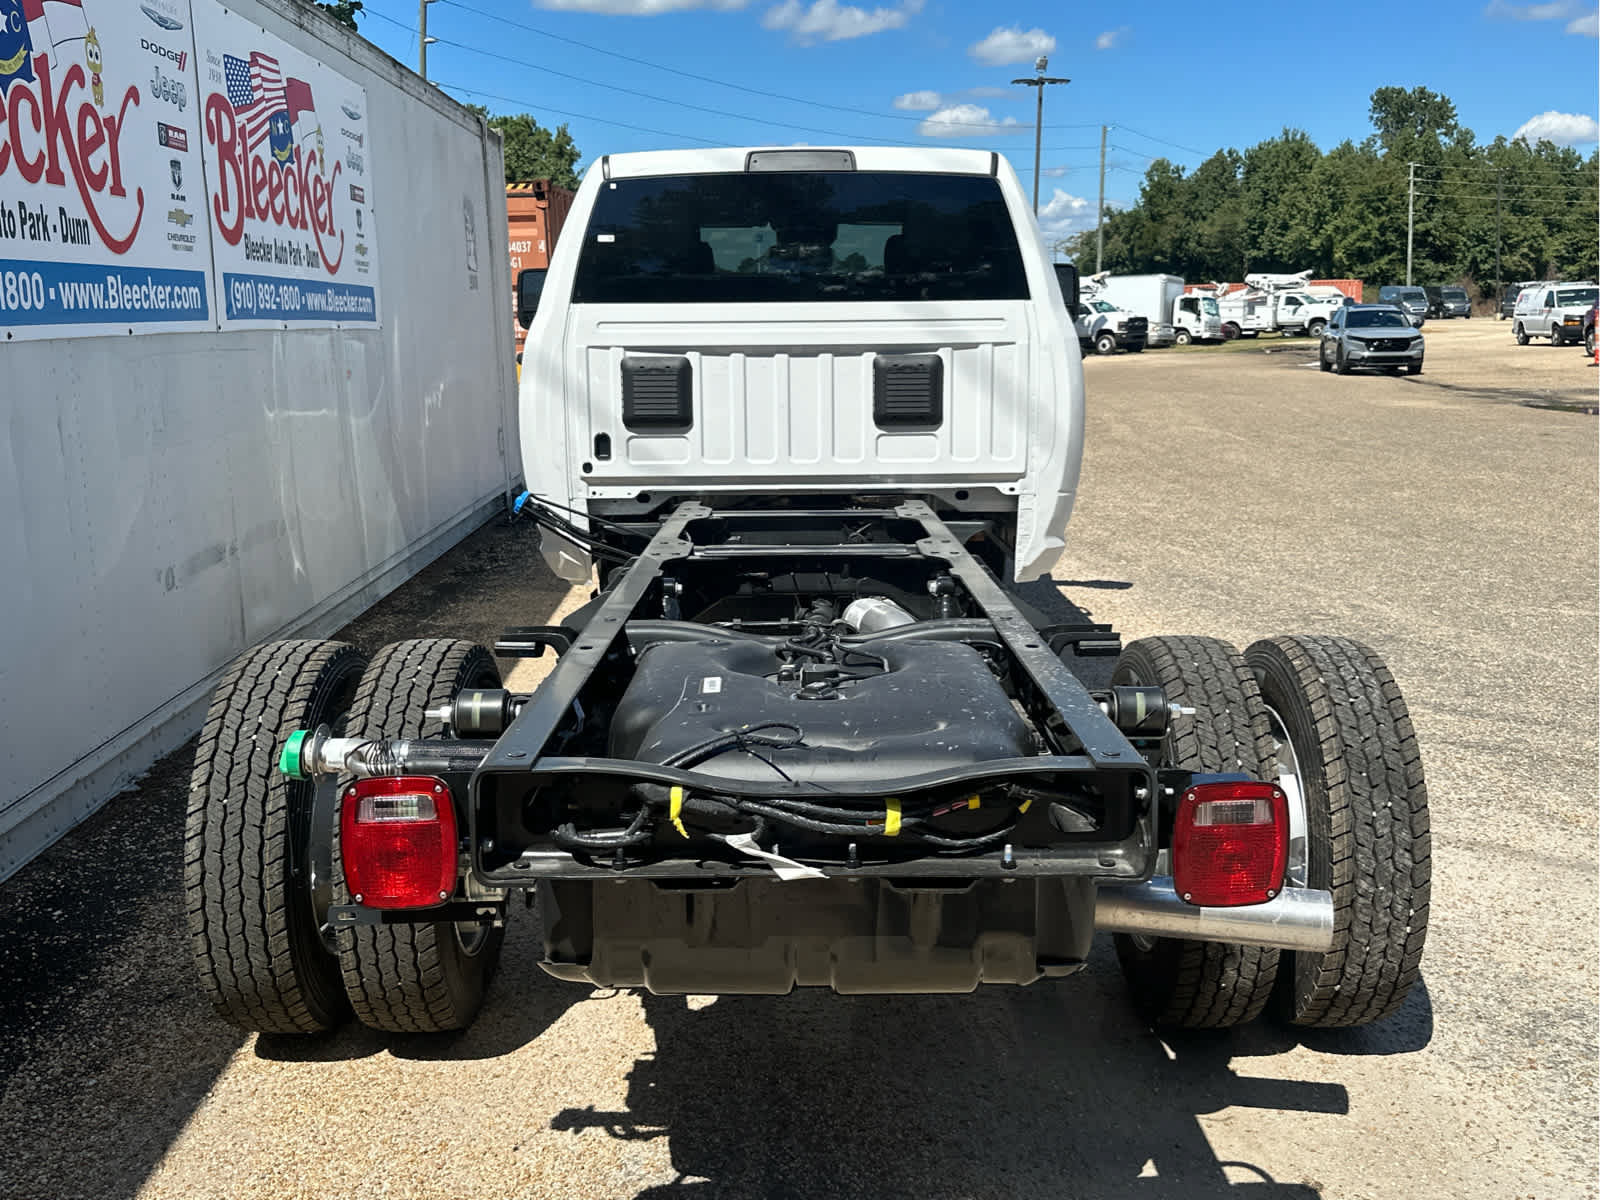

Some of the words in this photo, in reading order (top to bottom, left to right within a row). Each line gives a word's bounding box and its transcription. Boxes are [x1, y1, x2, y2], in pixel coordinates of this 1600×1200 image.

[140, 38, 183, 65] DODGE
[150, 65, 187, 112] Jeep
[0, 52, 145, 255] cker
[168, 129, 187, 141] RAM
[206, 92, 344, 276] Bleecker
[0, 199, 16, 240] to
[18, 200, 51, 242] Park
[58, 206, 91, 246] Dunn
[244, 232, 272, 263] Bleecker
[274, 237, 288, 265] Auto
[288, 240, 303, 267] Park
[58, 274, 201, 310] www.Bleecker.com
[230, 277, 257, 316] (910)
[257, 283, 300, 311] 892-1800
[306, 288, 373, 313] www.Bleecker.com
